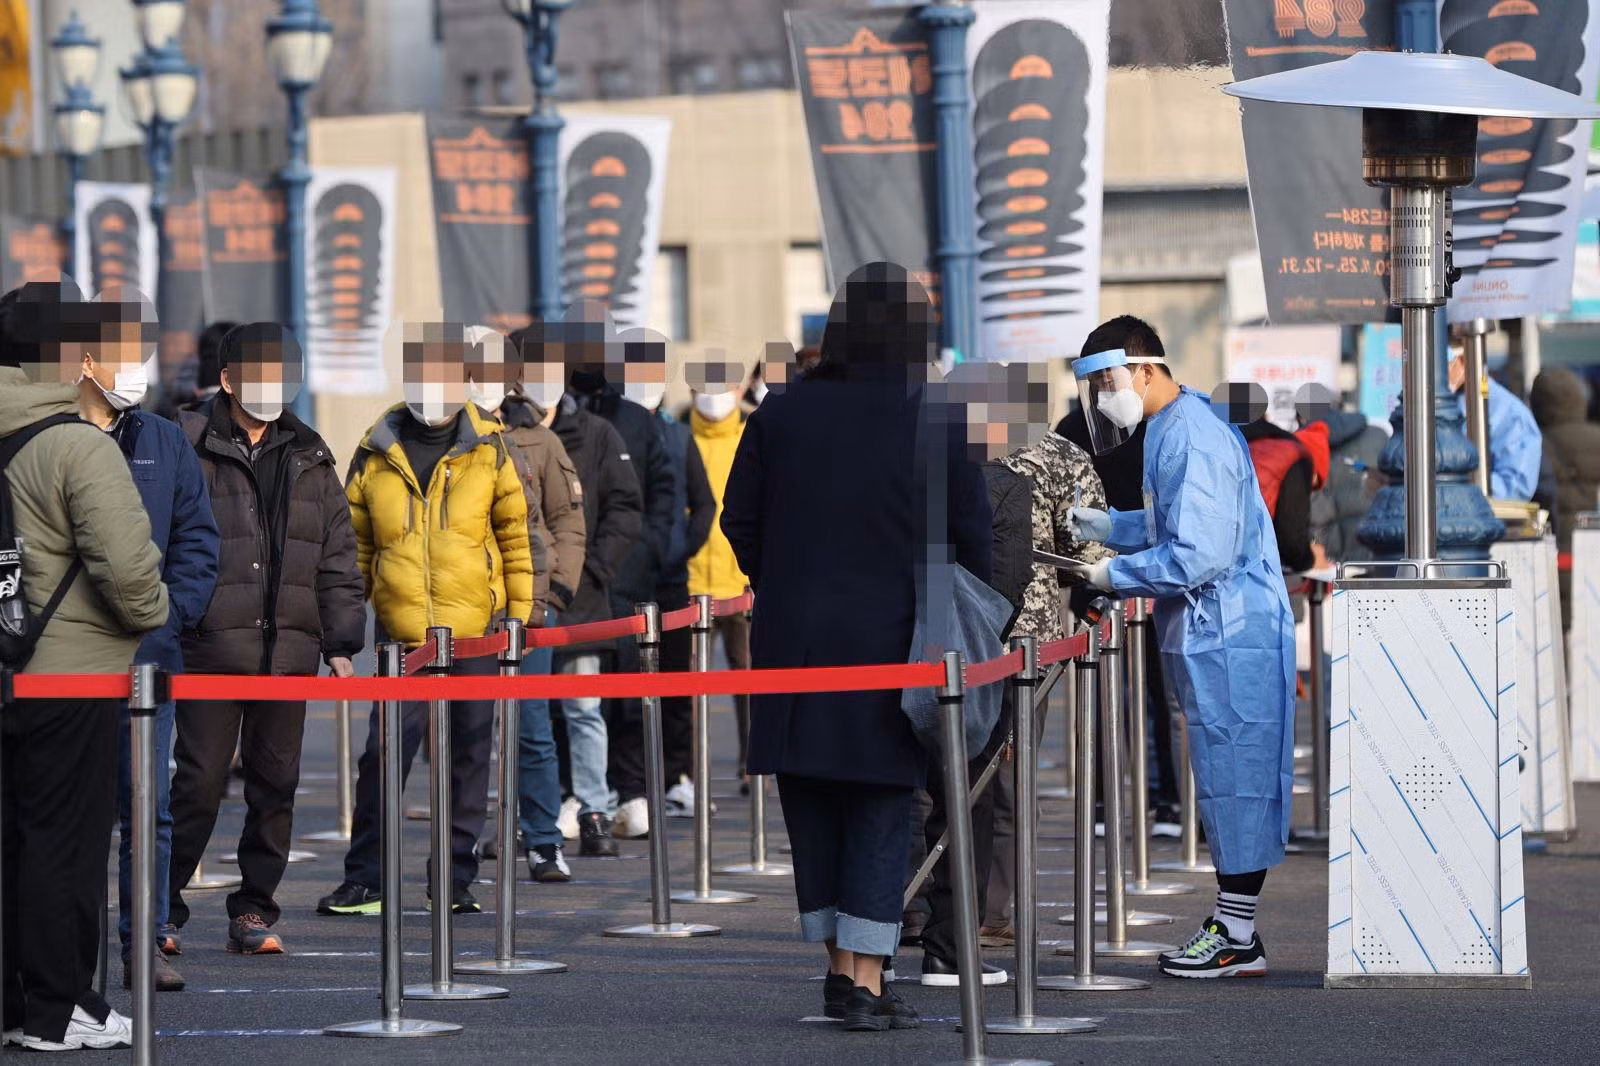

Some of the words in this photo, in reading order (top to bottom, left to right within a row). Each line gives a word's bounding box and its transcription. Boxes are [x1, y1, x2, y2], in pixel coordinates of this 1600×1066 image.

[1367, 855, 1382, 875] STEEL
[1437, 855, 1452, 874] STEEL
[1378, 875, 1402, 909] STAINLESS
[1447, 875, 1472, 909] STAINLESS
